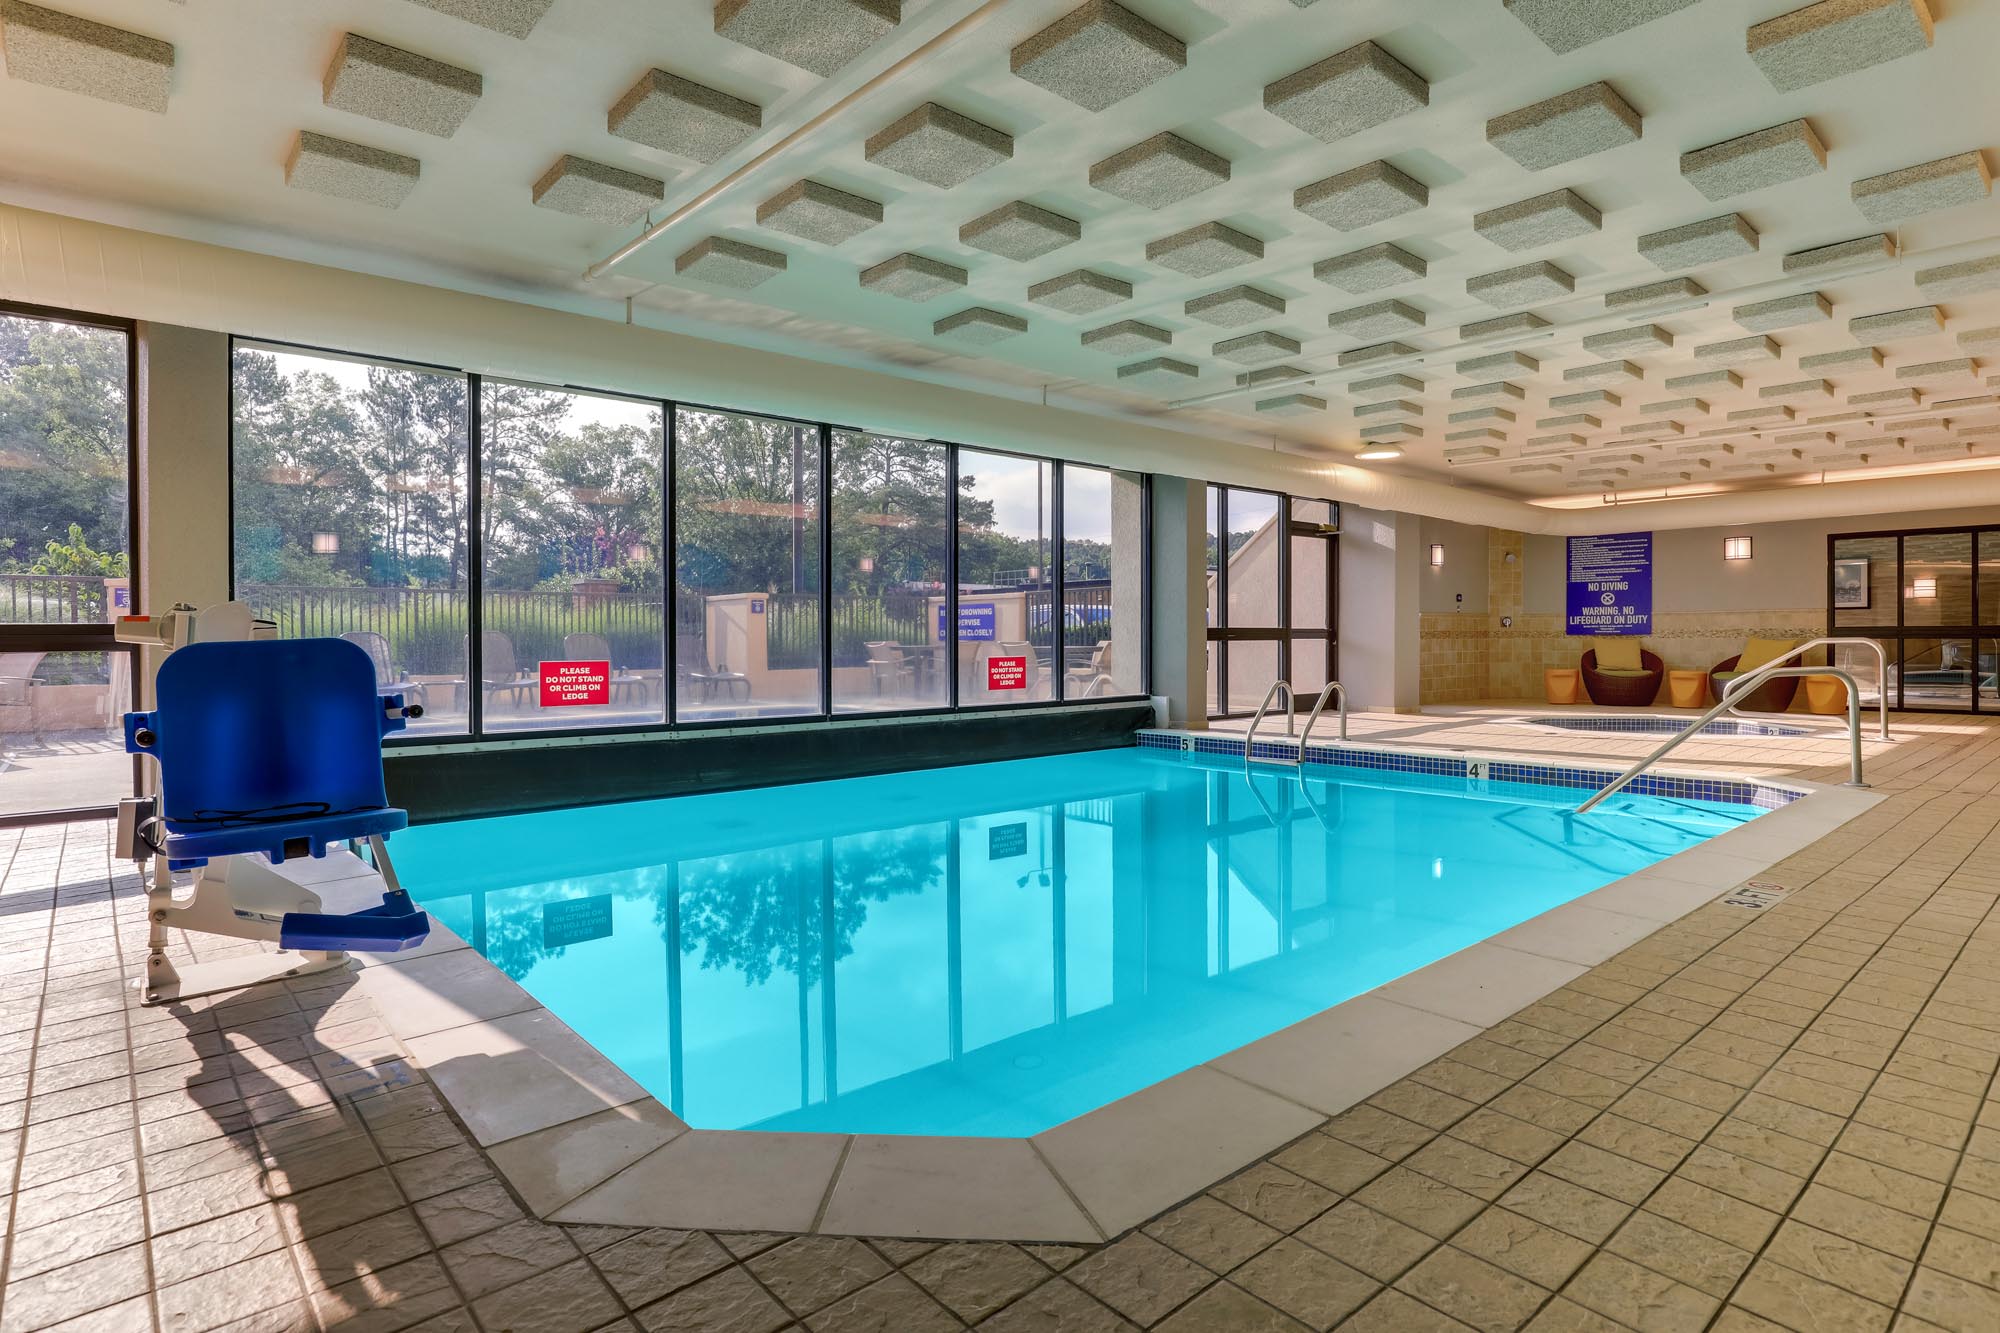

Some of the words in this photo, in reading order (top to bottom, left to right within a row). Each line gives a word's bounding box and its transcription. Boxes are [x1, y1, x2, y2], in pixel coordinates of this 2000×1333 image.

[1588, 583, 1599, 591] NO
[1601, 582, 1628, 591] DIVING
[961, 608, 992, 616] DROWNING
[1623, 606, 1634, 614] NO
[1569, 616, 1611, 625] LIFEGUARD
[1613, 615, 1625, 624] ON
[1627, 615, 1648, 624] DUTY
[560, 667, 590, 675] PLEASE
[578, 675, 604, 683] STAND
[562, 684, 587, 692] CLIMB
[1182, 738, 1188, 751] 5
[1469, 763, 1479, 778] 4
